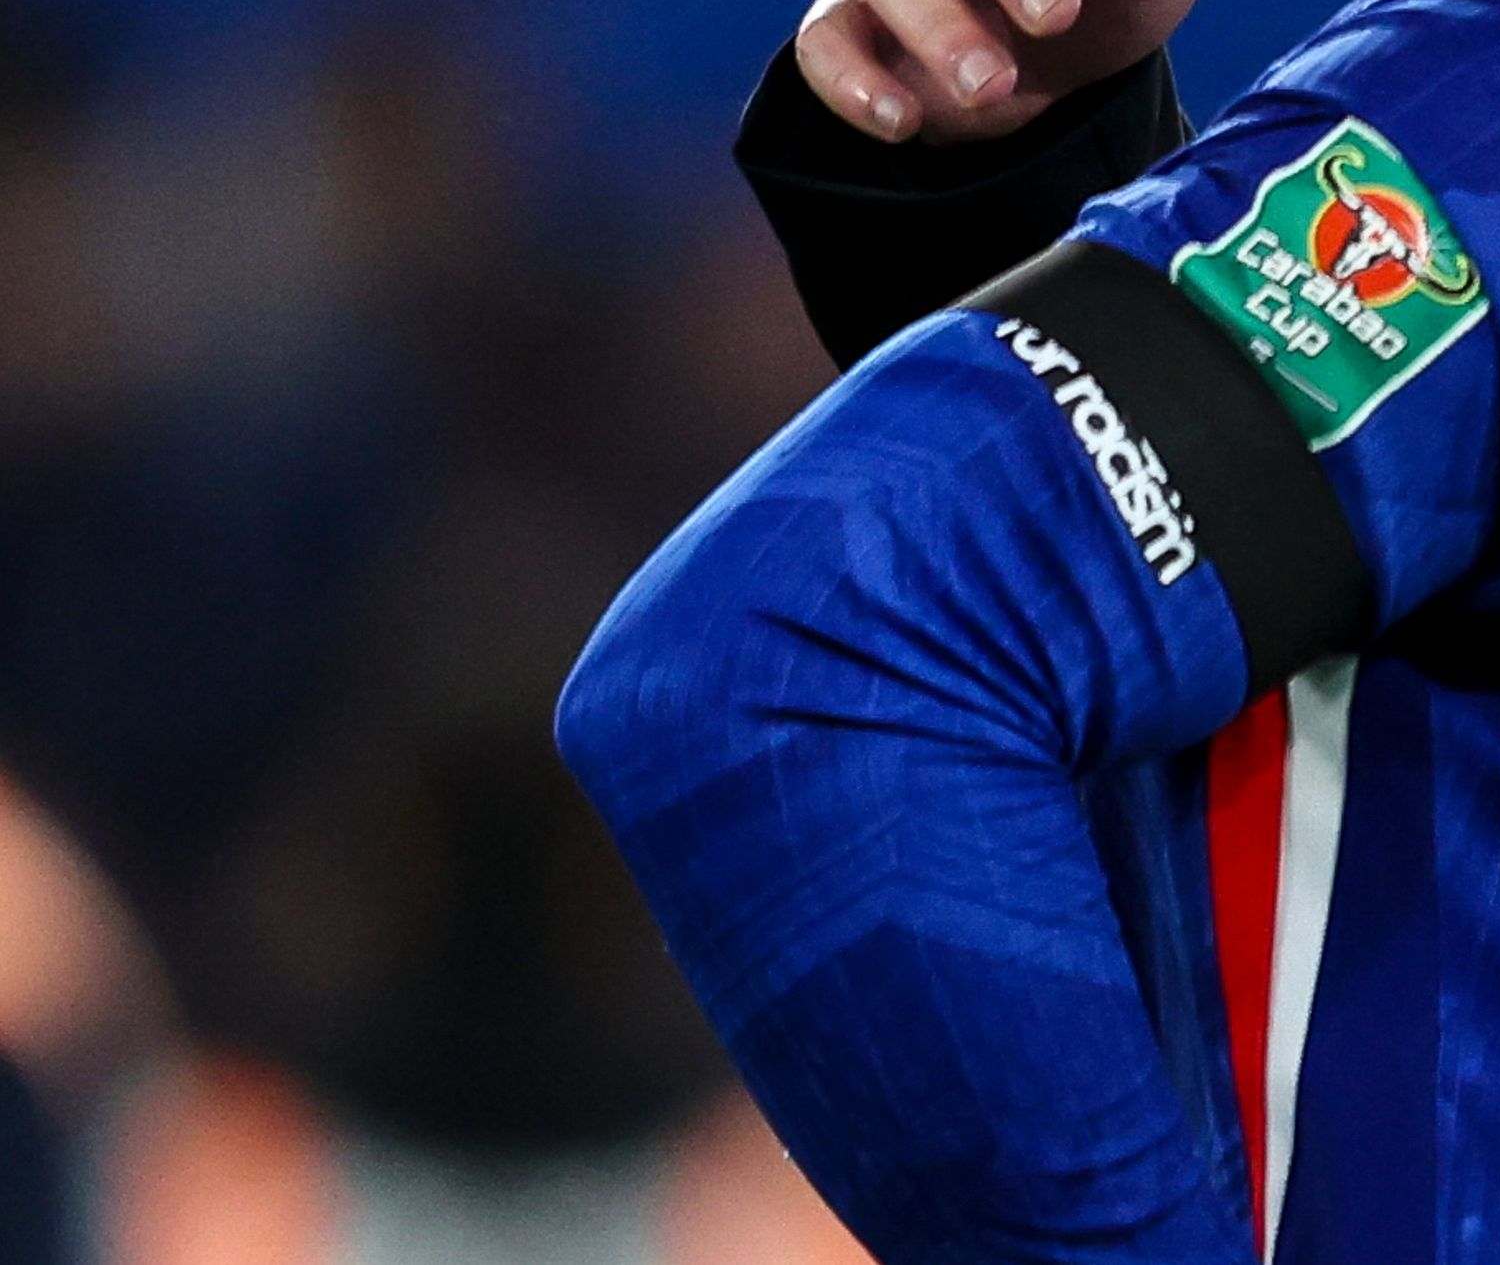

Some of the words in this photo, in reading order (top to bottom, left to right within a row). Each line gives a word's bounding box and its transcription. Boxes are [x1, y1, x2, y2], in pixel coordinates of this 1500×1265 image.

[1236, 227, 1407, 360] Carabao
[1245, 282, 1330, 357] Cup
[1054, 372, 1196, 586] racism
